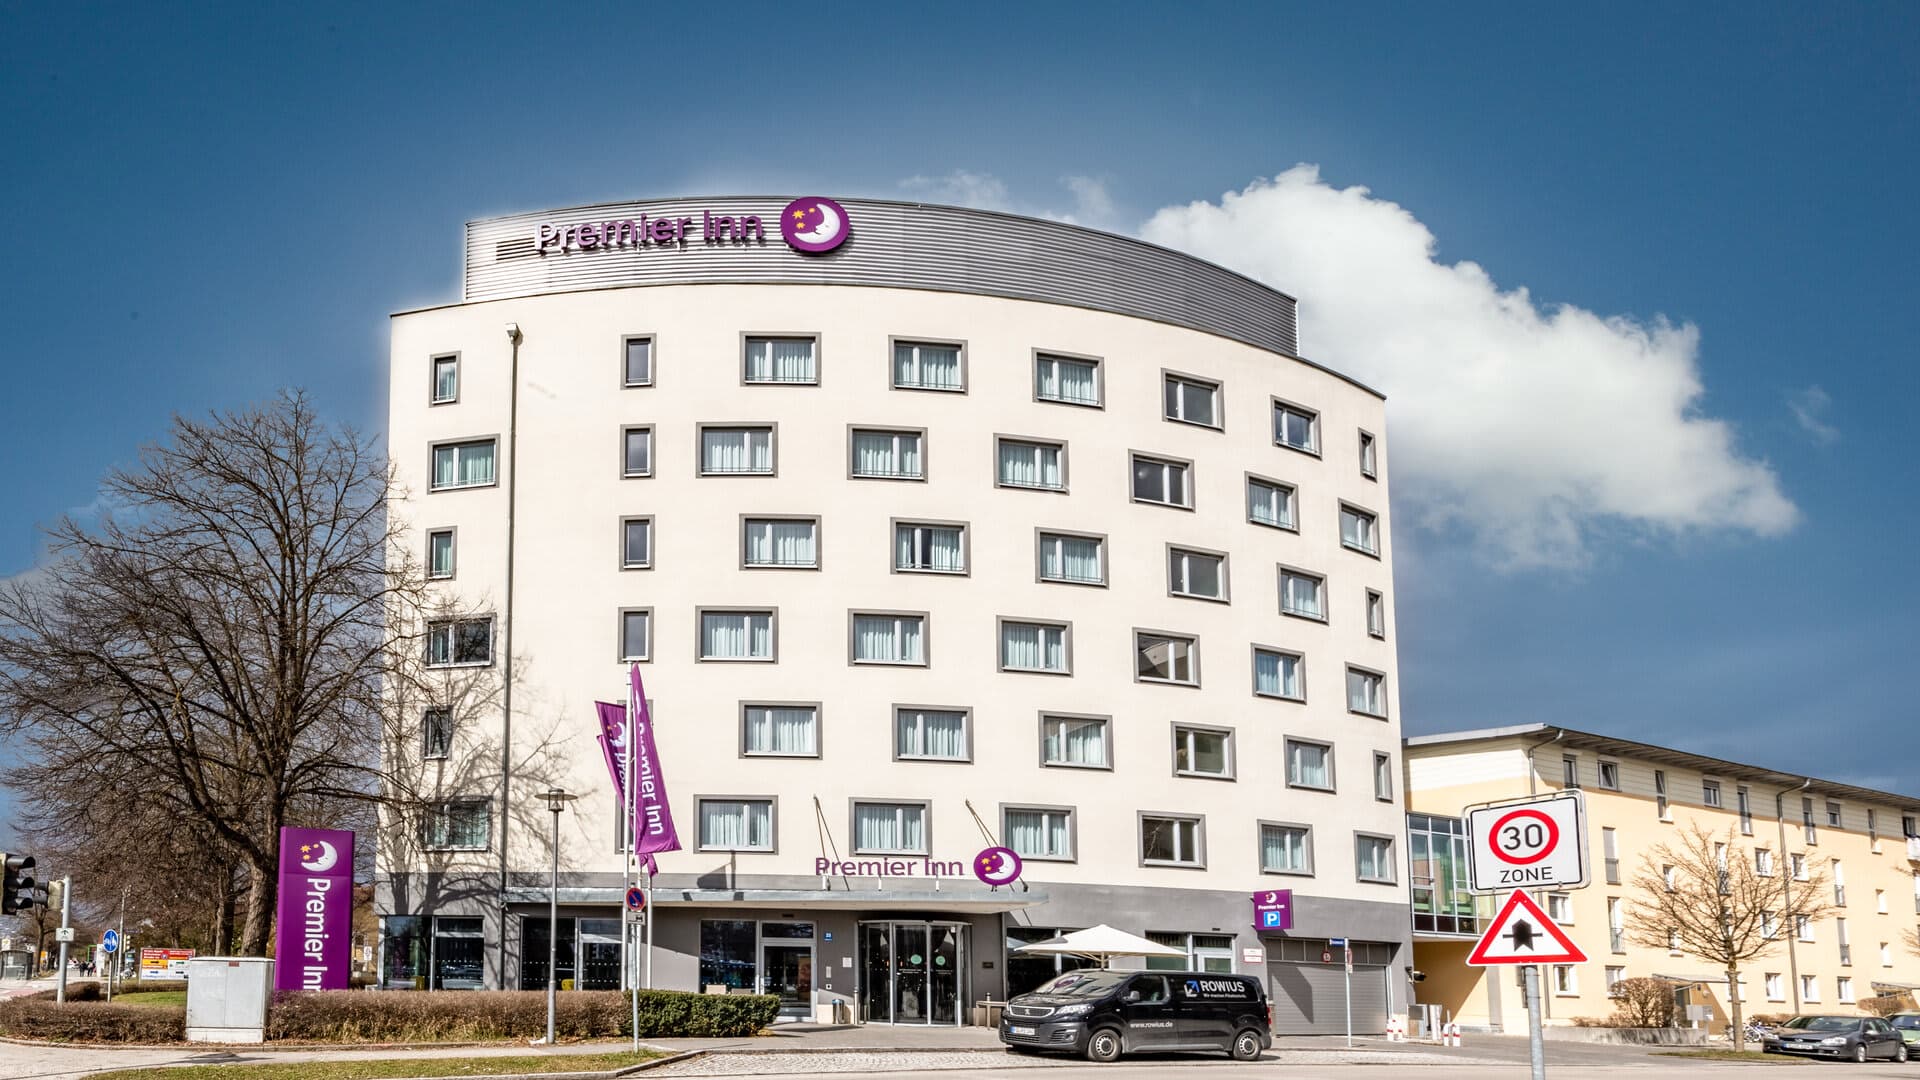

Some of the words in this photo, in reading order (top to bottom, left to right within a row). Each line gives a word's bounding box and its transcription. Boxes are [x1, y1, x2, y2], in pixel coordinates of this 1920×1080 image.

[535, 212, 692, 250] Premier
[703, 210, 763, 240] Inn
[645, 805, 664, 835] Inn
[1503, 824, 1543, 850] 30
[815, 857, 917, 876] Premier
[925, 857, 965, 876] Inn
[1500, 867, 1553, 883] ZONE
[304, 878, 331, 962] Premier
[1267, 913, 1277, 925] P
[1200, 980, 1245, 992] ROWIUS
[1130, 1021, 1173, 1029] www.rowius.de
